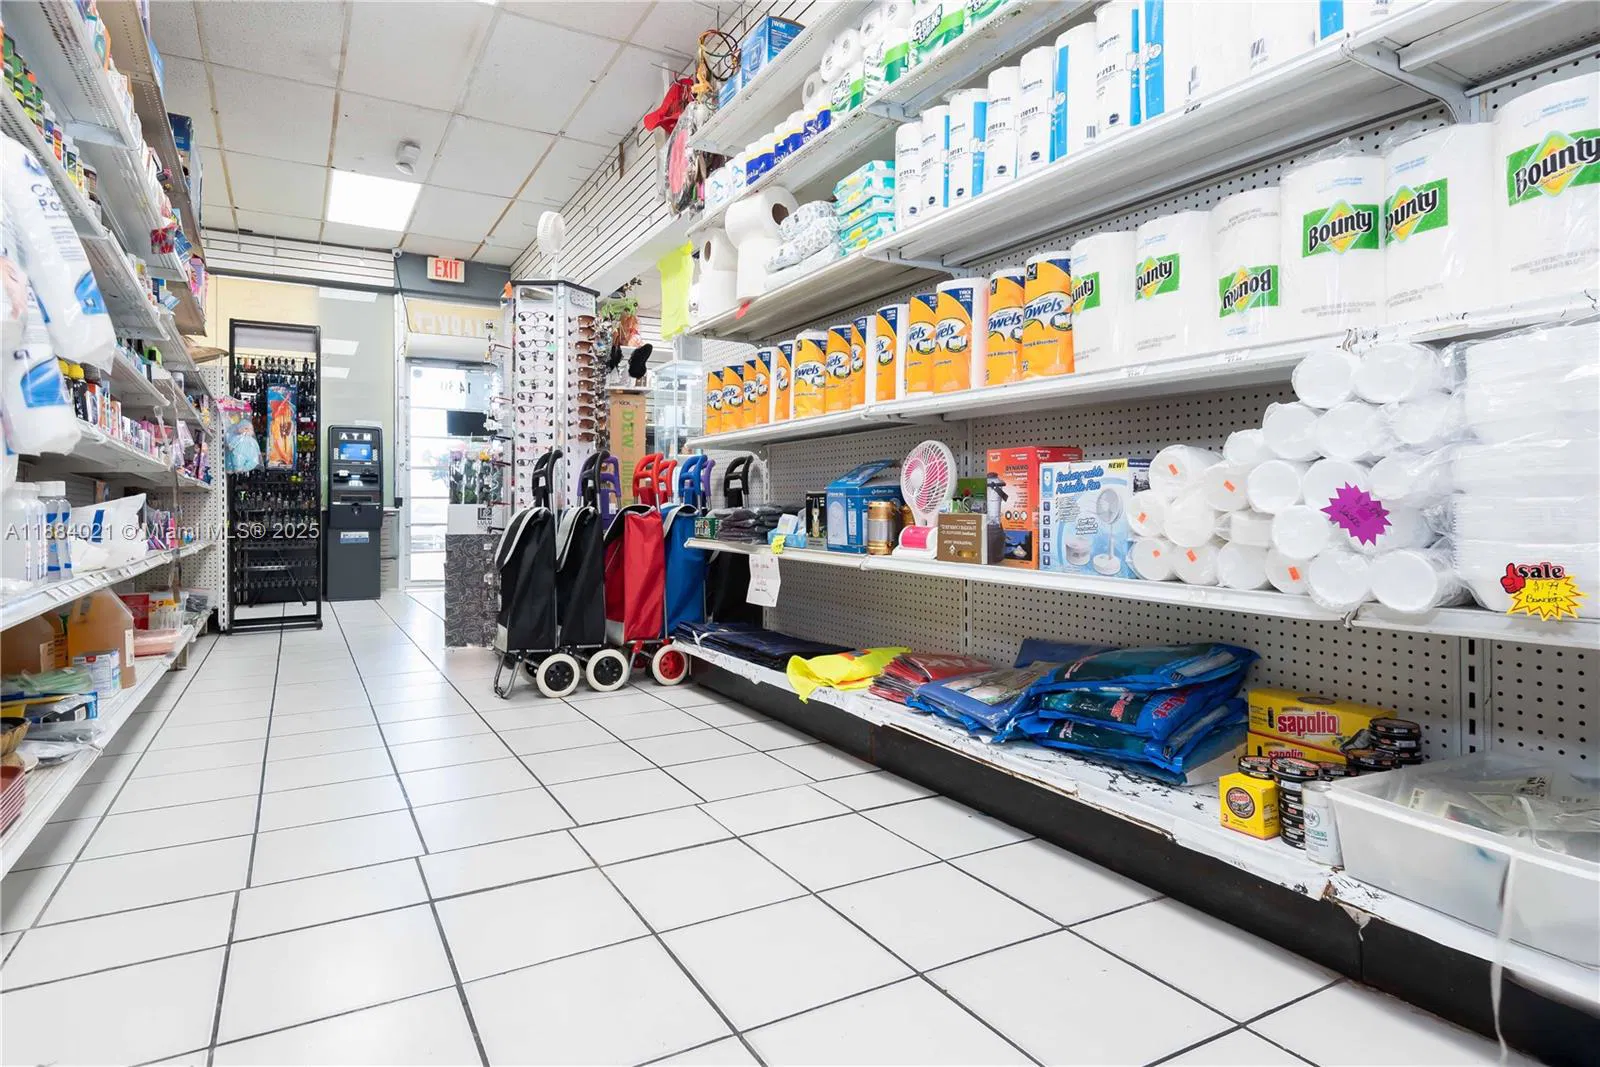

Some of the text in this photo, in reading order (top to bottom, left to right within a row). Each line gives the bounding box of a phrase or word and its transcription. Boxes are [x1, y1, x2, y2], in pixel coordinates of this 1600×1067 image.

[1514, 136, 1600, 199] Bounty
[1308, 210, 1373, 252] Bounty
[434, 258, 459, 280] EXIT
[1136, 261, 1172, 291] ounty
[1072, 279, 1094, 304] unty
[1222, 269, 1272, 309] Bounty
[340, 432, 371, 441] ATM
[1518, 564, 1562, 579] sale
[1223, 813, 1228, 822] 3
